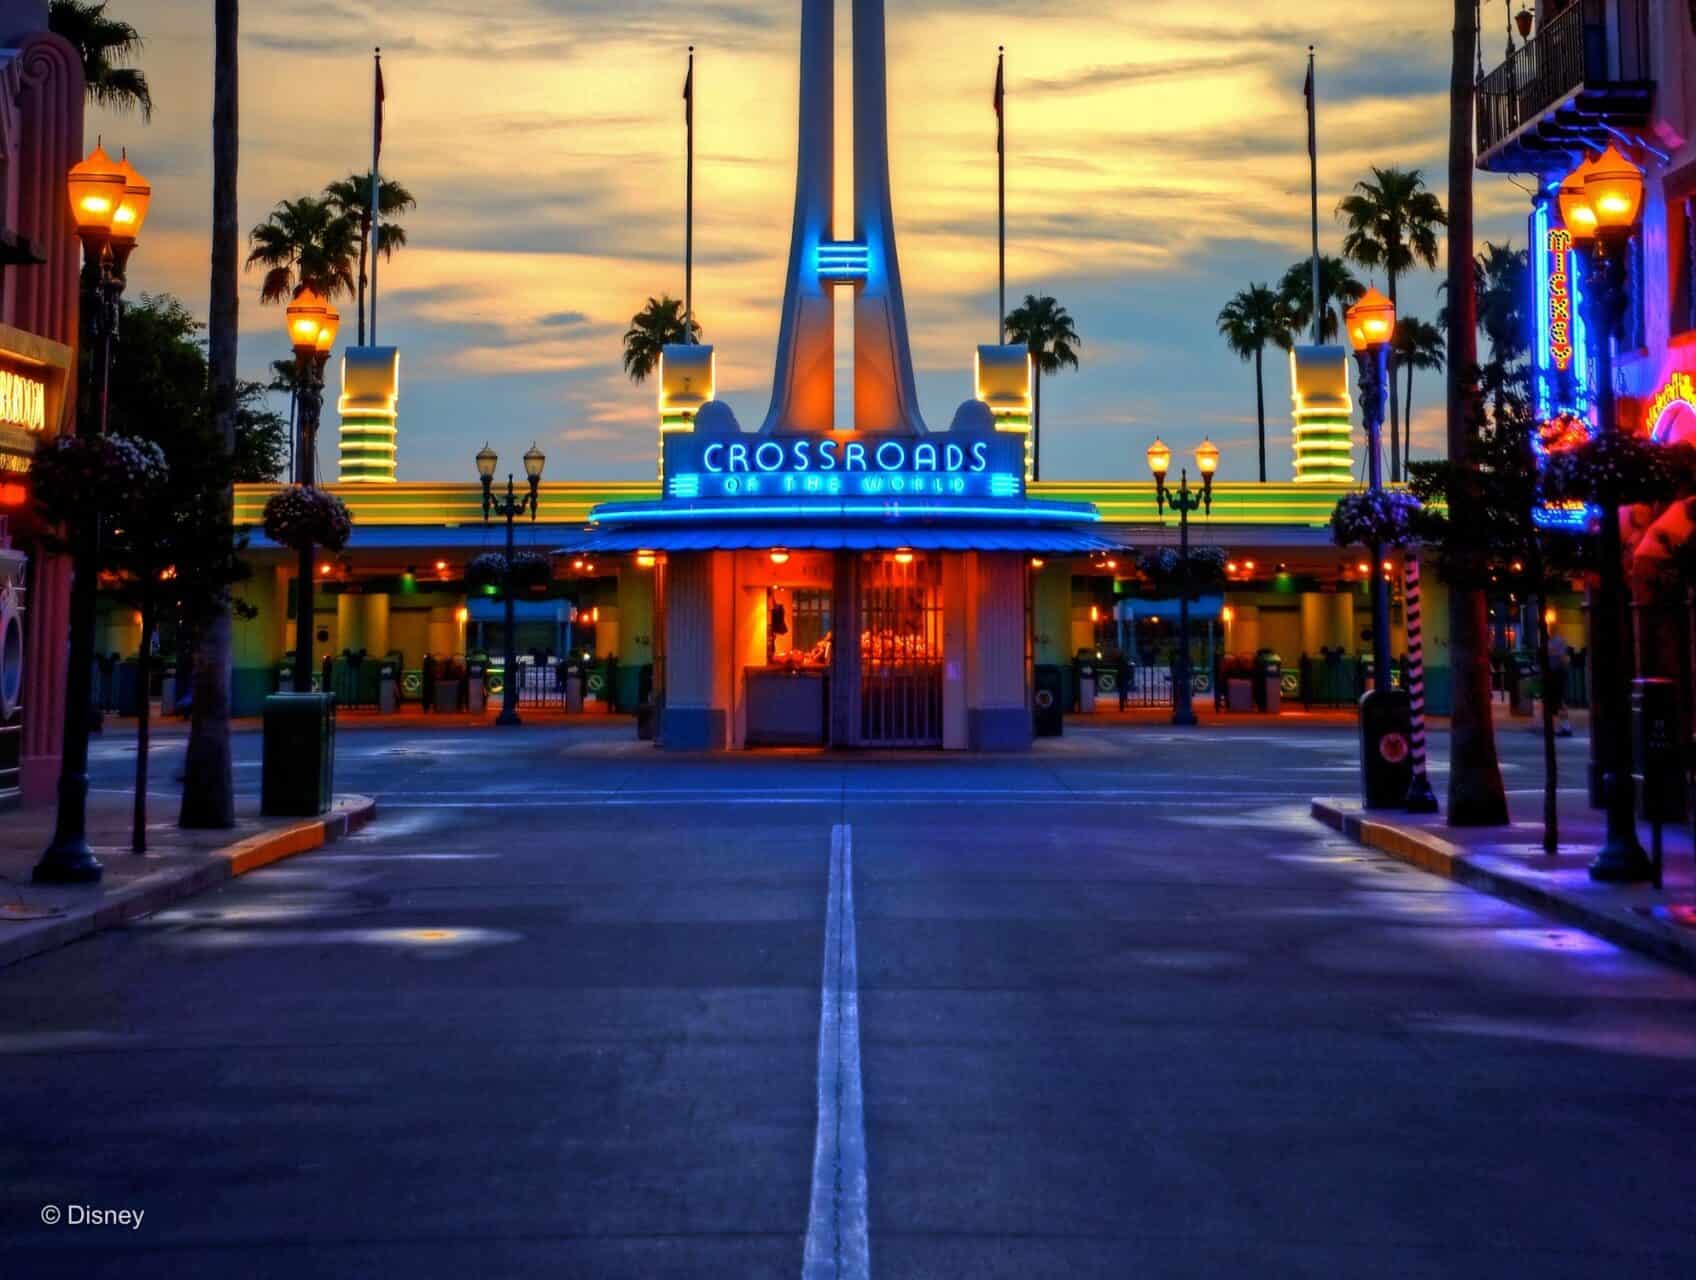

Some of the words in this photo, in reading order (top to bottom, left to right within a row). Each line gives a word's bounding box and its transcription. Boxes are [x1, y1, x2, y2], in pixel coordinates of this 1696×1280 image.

[703, 440, 987, 473] CROSSROADS
[723, 477, 759, 493] OF
[784, 477, 841, 493] THE
[862, 476, 966, 493] WORLD
